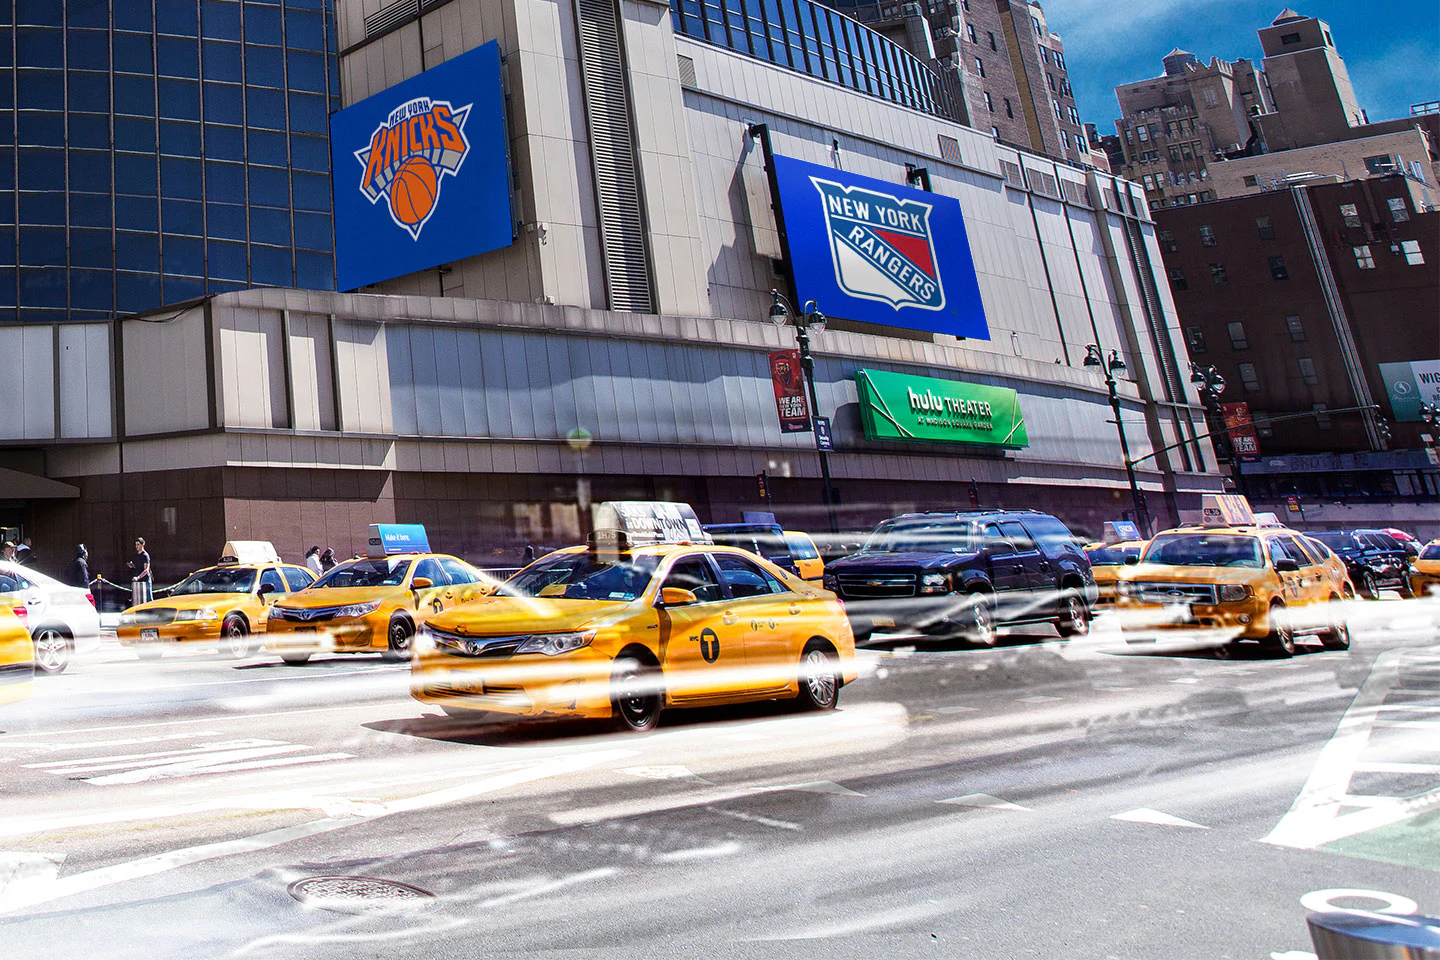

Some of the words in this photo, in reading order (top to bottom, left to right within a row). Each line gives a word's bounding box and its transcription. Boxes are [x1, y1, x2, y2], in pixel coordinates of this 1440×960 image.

[389, 108, 407, 128] NEW
[407, 99, 430, 118] YORK
[363, 105, 466, 189] KNICKS
[828, 194, 870, 220] NEW
[875, 205, 925, 233] YORK
[848, 225, 936, 300] RANGERS
[779, 397, 791, 405] WE
[791, 395, 805, 404] ARE
[780, 407, 806, 417] TEAM
[907, 386, 943, 411] hulu
[944, 397, 993, 417] THEATER
[1235, 444, 1257, 452] TEAM
[631, 518, 688, 530] DOWNTOWN
